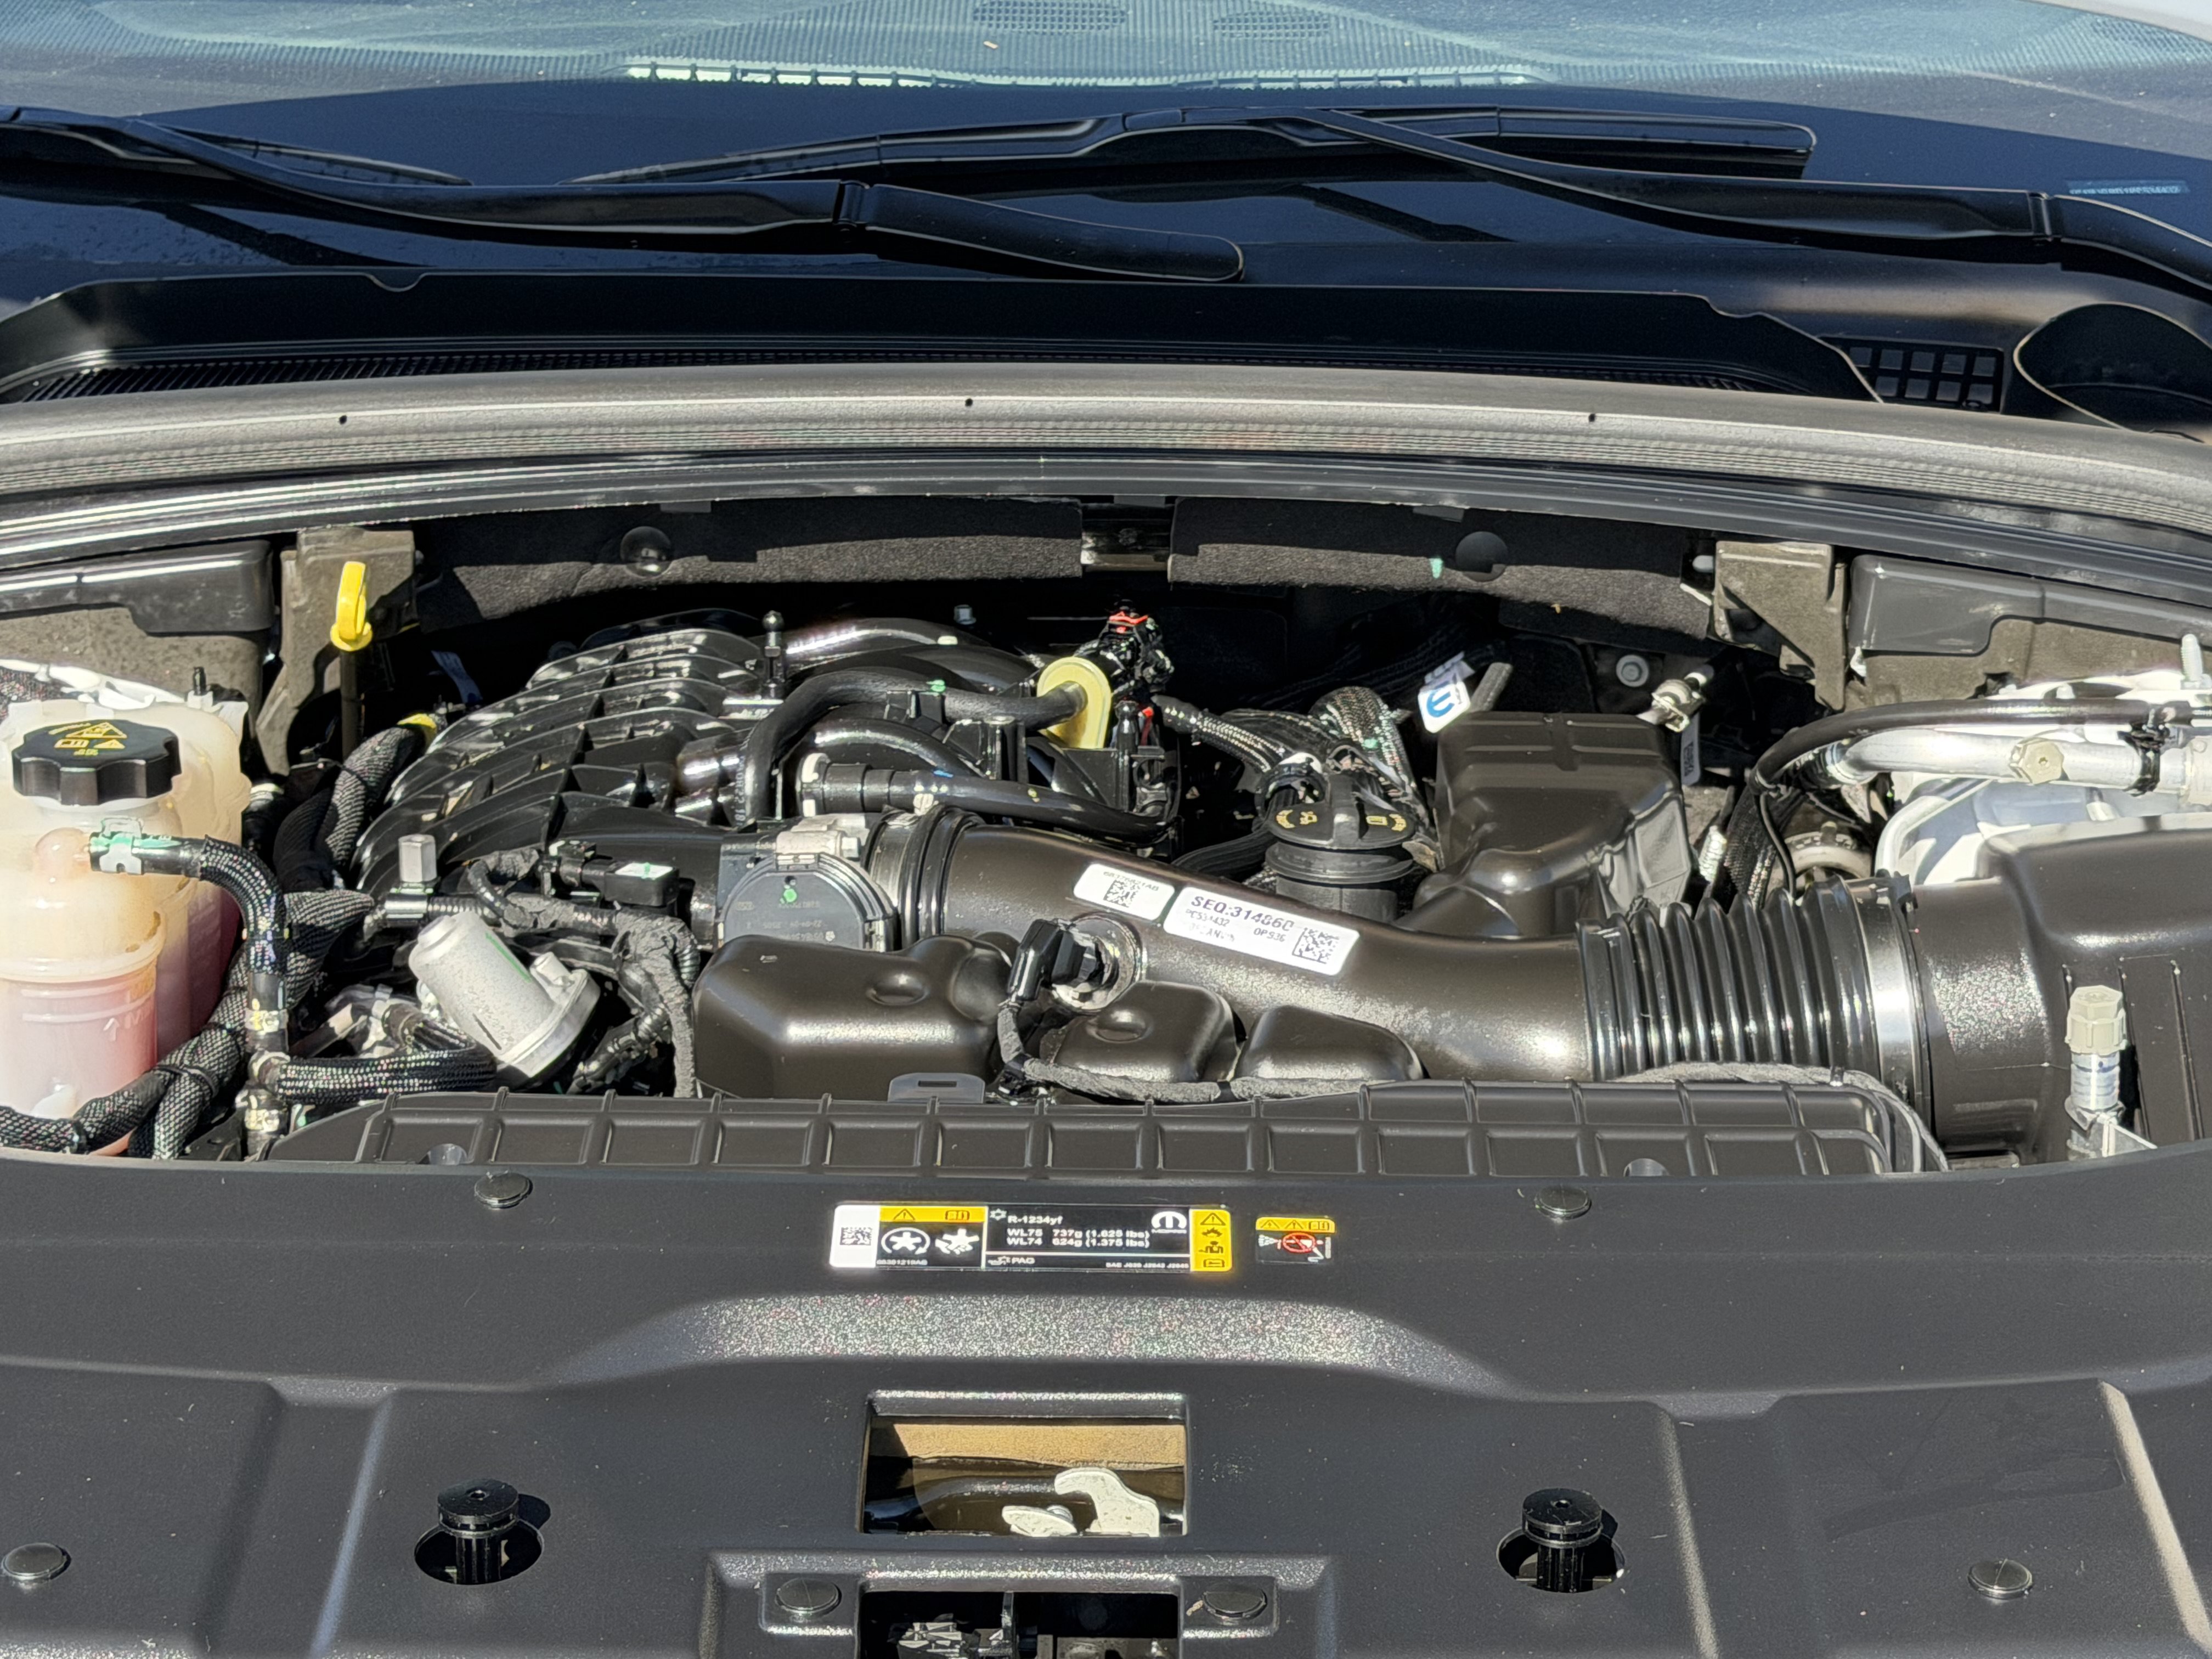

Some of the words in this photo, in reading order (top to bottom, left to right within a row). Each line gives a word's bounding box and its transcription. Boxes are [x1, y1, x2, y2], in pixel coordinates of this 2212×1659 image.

[1007, 1215, 1063, 1226] R-1234yf
[1007, 1228, 1043, 1237] WL75
[1052, 1228, 1083, 1238] 737g
[1125, 1229, 1150, 1239] lbs)
[1007, 1237, 1043, 1246] WL74
[1052, 1238, 1083, 1248] 624g
[1085, 1238, 1123, 1248] (1.375
[1125, 1238, 1150, 1249] lbs)
